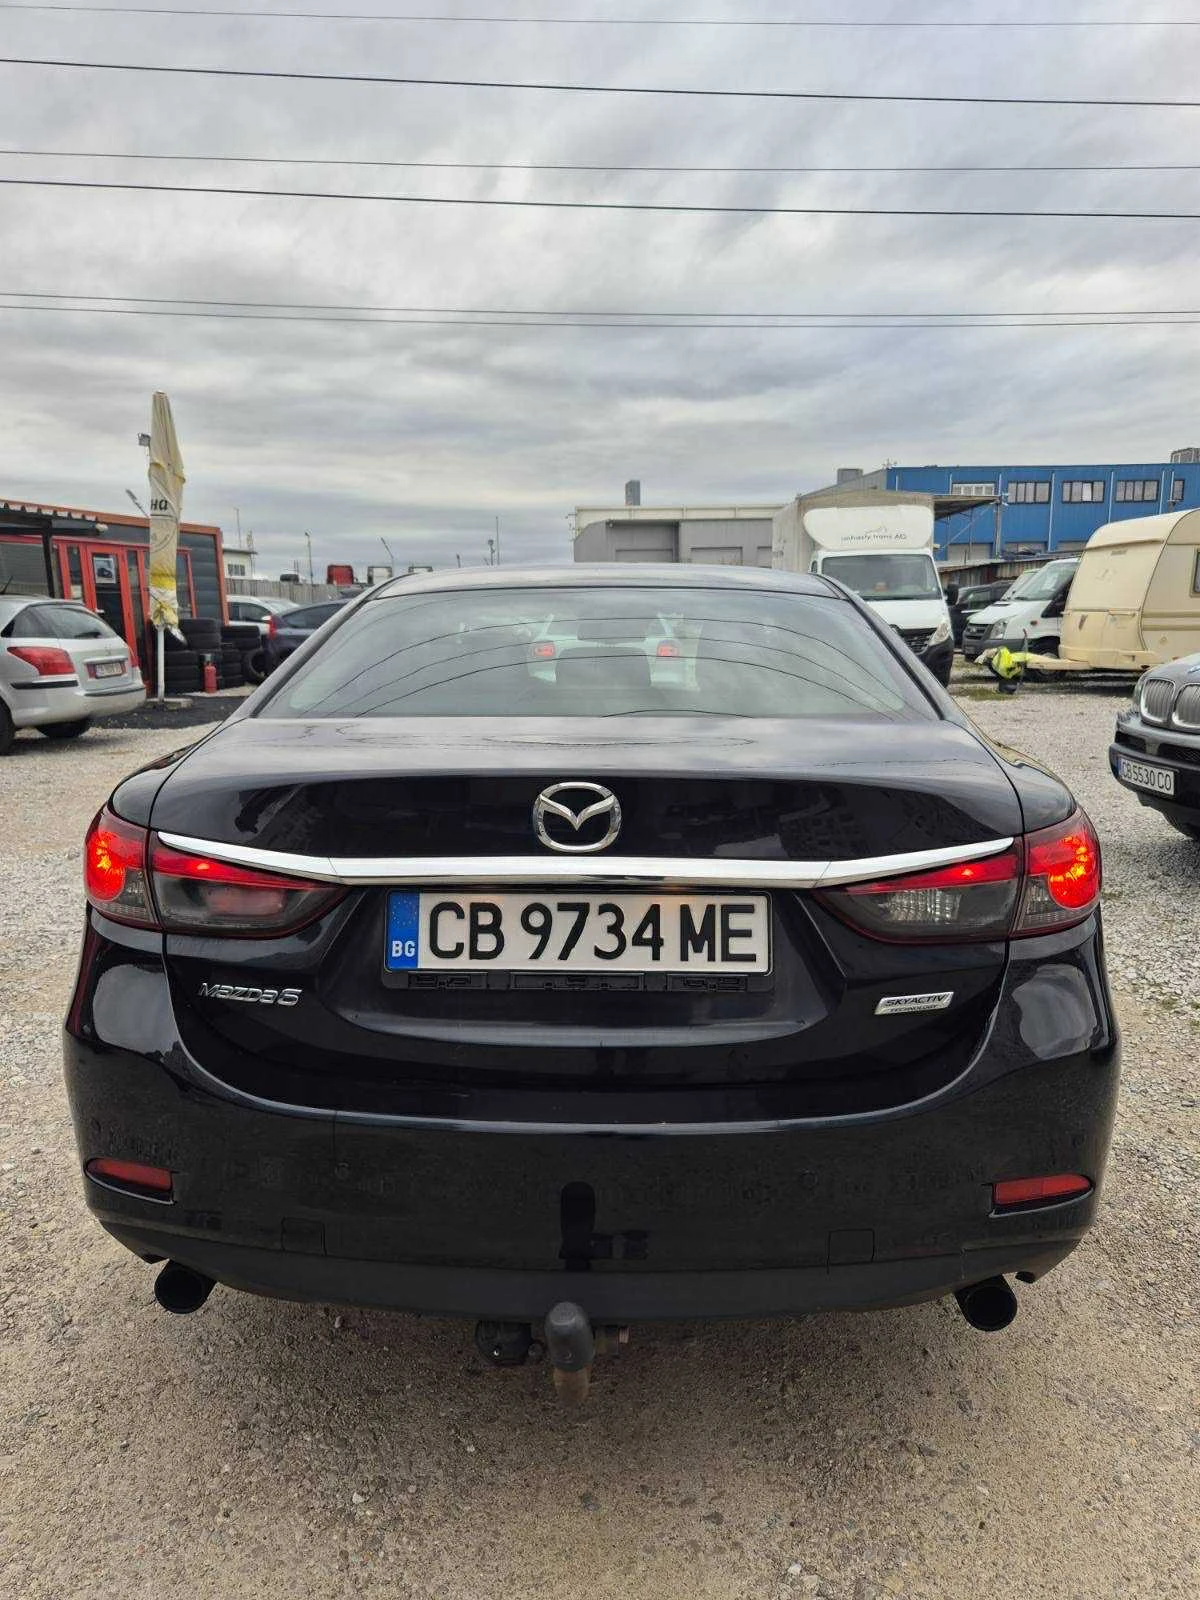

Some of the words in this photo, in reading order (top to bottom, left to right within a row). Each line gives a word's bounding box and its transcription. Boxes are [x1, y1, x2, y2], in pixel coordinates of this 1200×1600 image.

[429, 901, 505, 961] CB
[520, 901, 665, 961] 9734
[679, 903, 757, 963] ME
[391, 940, 416, 957] BG
[885, 994, 946, 1007] SKYACTIV
